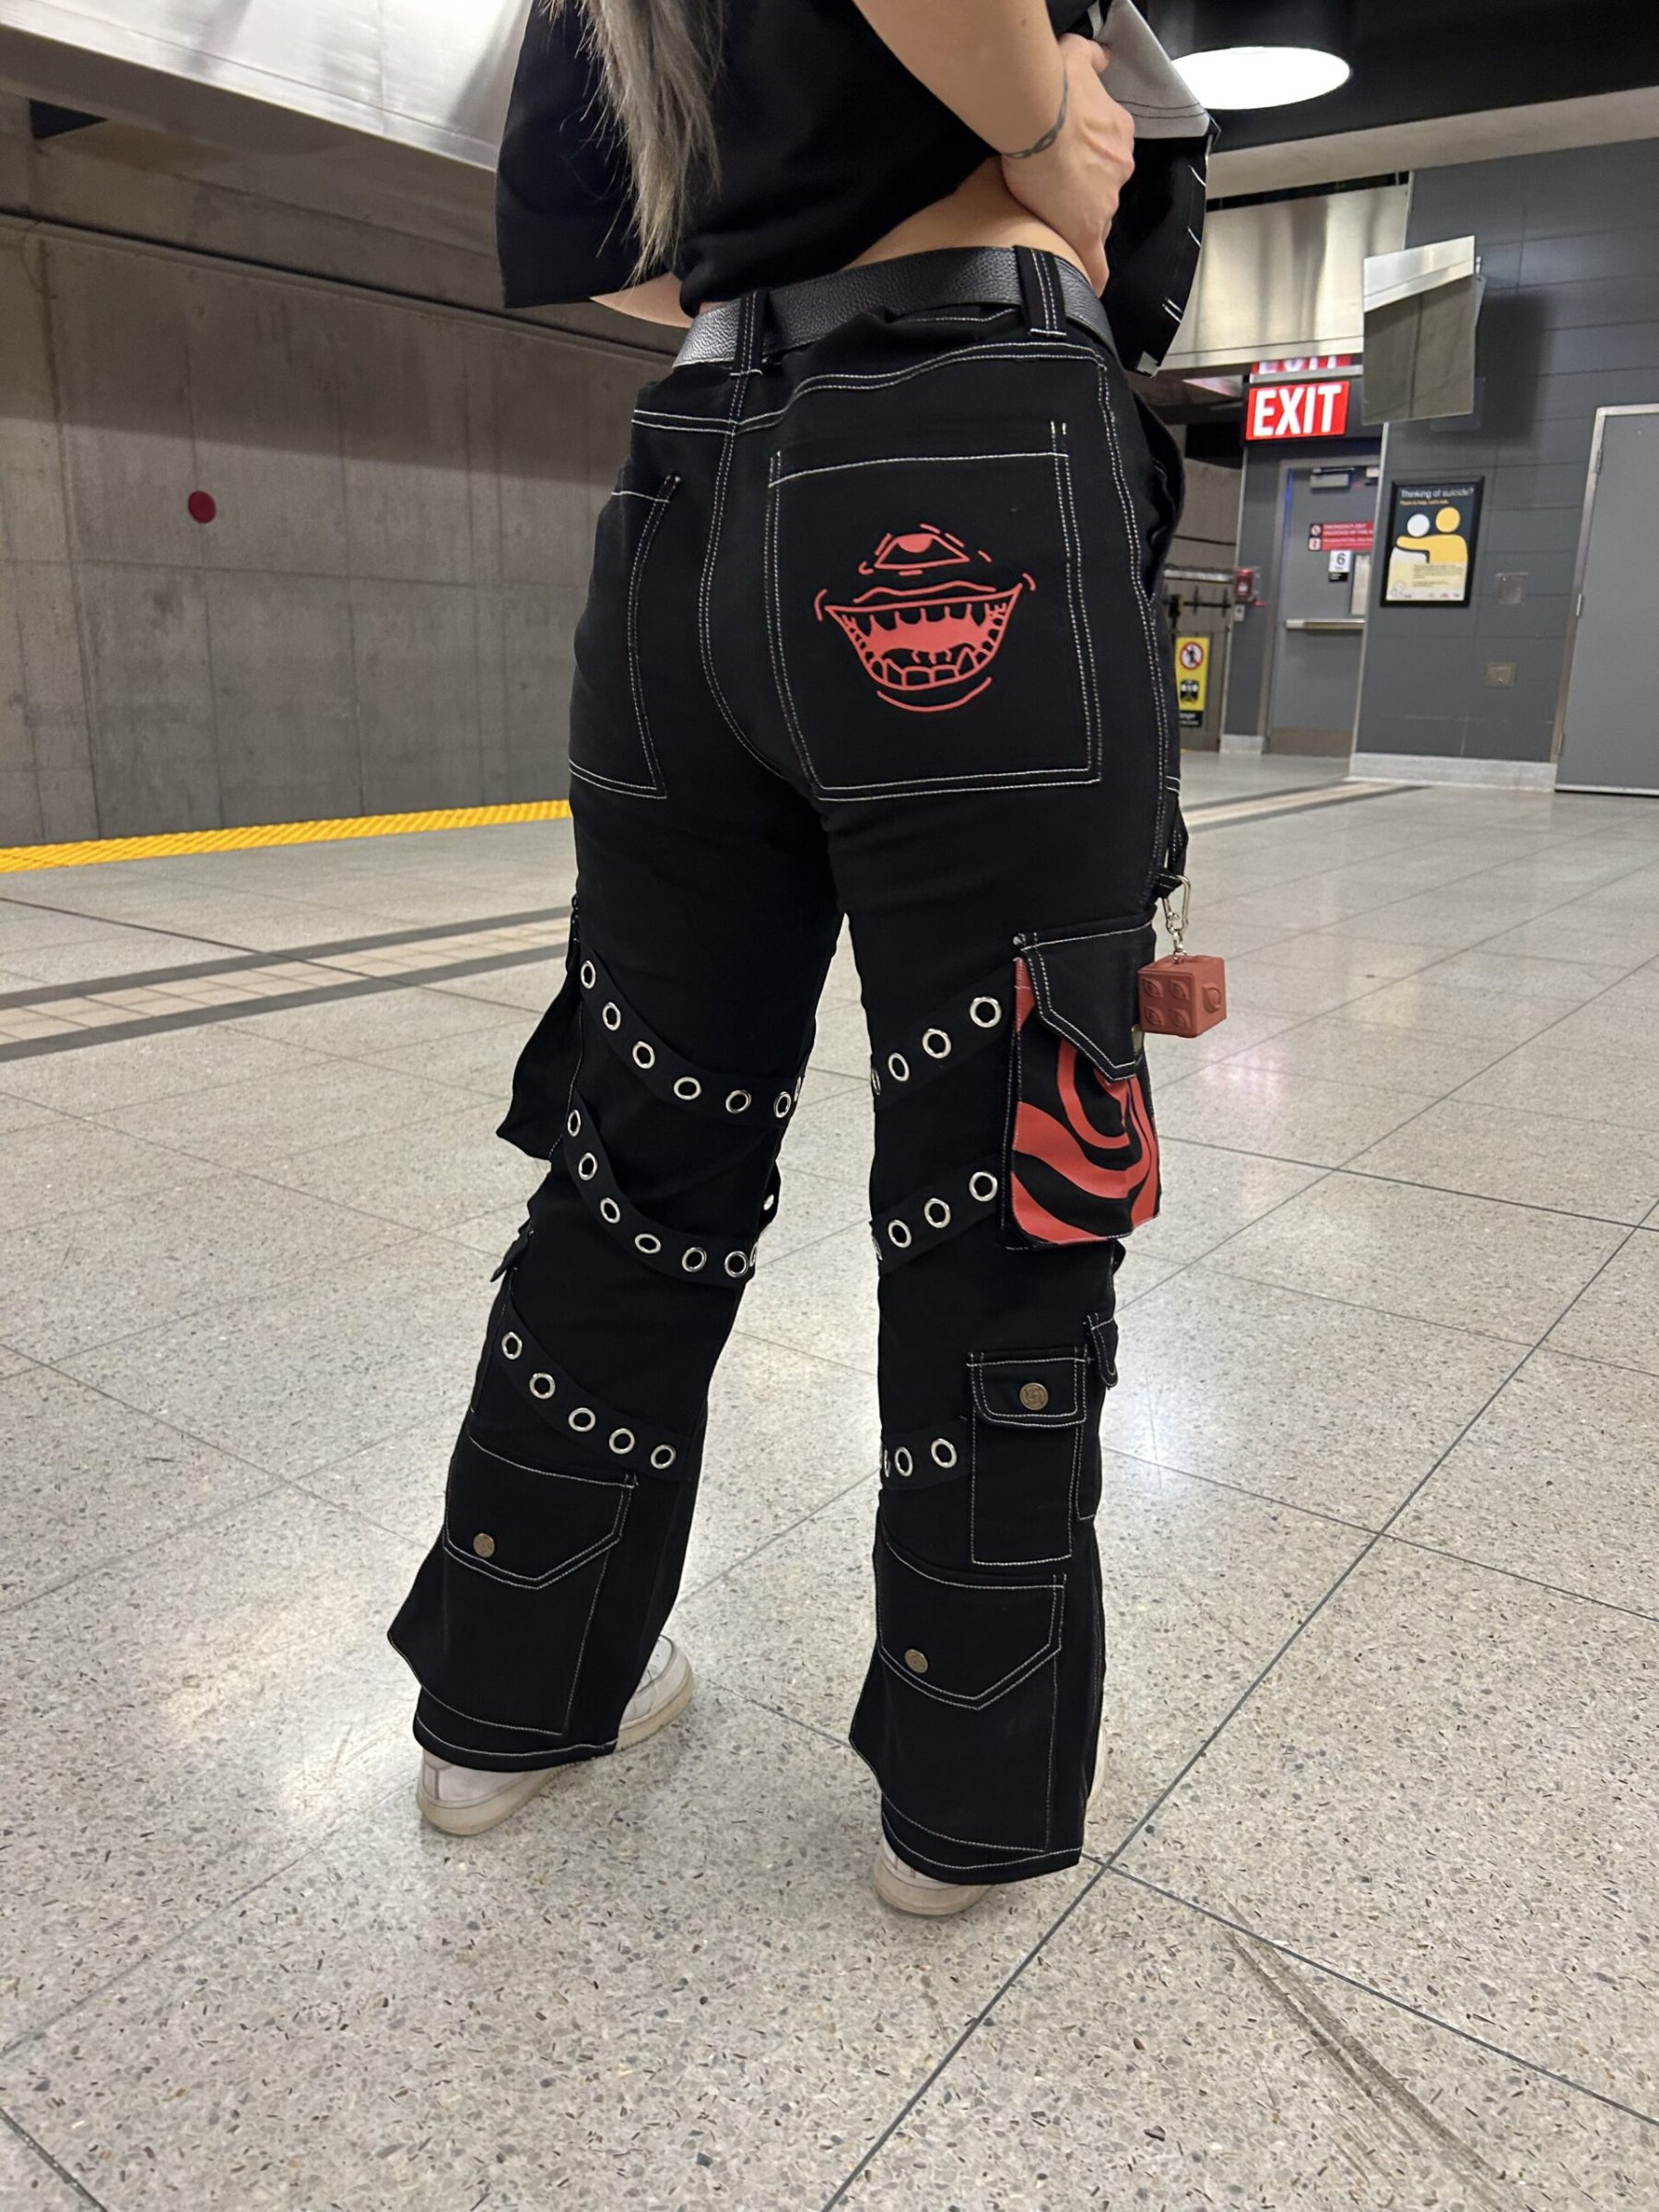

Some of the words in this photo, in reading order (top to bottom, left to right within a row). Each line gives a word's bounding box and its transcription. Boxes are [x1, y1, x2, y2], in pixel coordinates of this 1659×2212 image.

[1253, 384, 1342, 437] EXIT
[1401, 488, 1431, 500] Thinking
[1432, 488, 1441, 498] of
[1442, 487, 1475, 498] suicide?
[1336, 552, 1346, 566] 6
